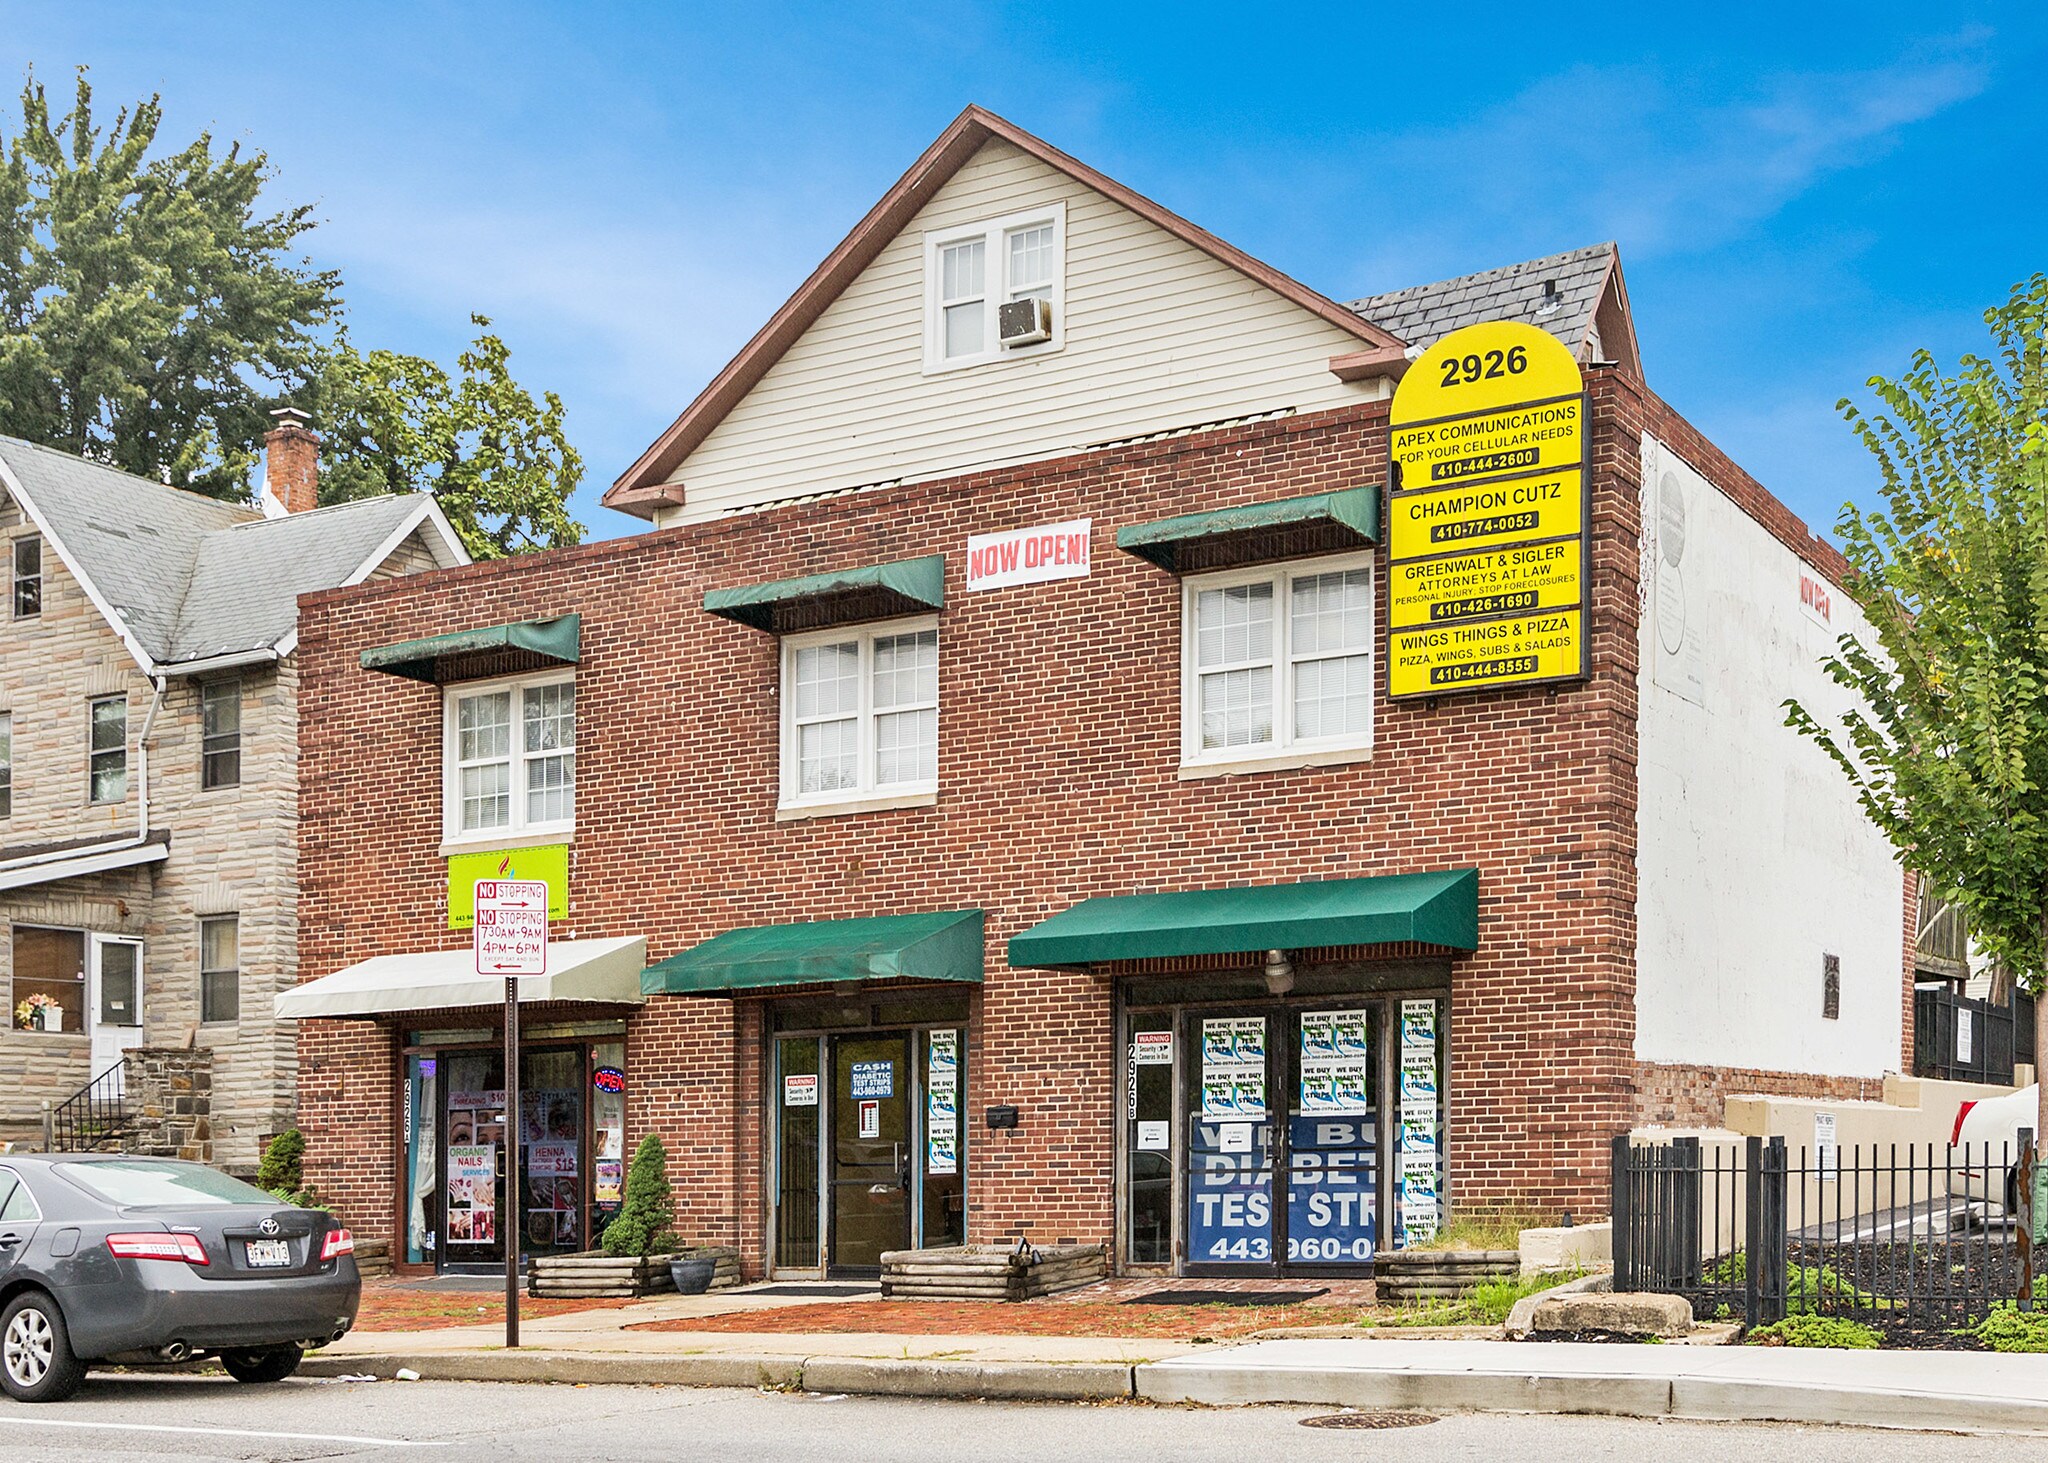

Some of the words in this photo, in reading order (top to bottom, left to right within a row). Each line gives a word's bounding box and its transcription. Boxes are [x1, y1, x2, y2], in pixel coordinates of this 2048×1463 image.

[1440, 345, 1528, 388] 2926
[1397, 430, 1435, 448] APEX
[1440, 406, 1576, 442] COMMUNICATIONS
[1400, 450, 1424, 464] FOR
[1427, 444, 1460, 459] YOUR
[1464, 433, 1528, 452] CELLULAR
[1531, 425, 1574, 441] NEEDS
[1437, 450, 1533, 477] 410-444-2600
[1410, 491, 1507, 520] CHAMPION
[1513, 482, 1561, 504] CUTZ
[1436, 514, 1533, 539] 410-774-0052
[970, 539, 1021, 581] NOW
[1025, 533, 1088, 568] OPEN!
[1405, 556, 1494, 580] GREENWALT
[1498, 554, 1508, 566] &
[1512, 545, 1565, 565] SIGLER
[1395, 593, 1440, 606] PERSONAL
[1479, 584, 1502, 594] STOP
[1504, 573, 1576, 591] FORECLOSURES
[1418, 572, 1497, 592] ATTORNEYS
[1501, 569, 1518, 581] AT
[1523, 564, 1552, 578] LAW
[1436, 593, 1532, 617] 410-426-1690
[1401, 632, 1449, 650] WINGS
[1453, 625, 1507, 644] THINGS
[1512, 623, 1522, 636] &
[1527, 617, 1570, 634] PIZZA
[1399, 655, 1434, 667] PIZZA,
[1436, 649, 1476, 662] WINGS,
[1479, 645, 1510, 657] SUBS
[1513, 643, 1521, 652] &
[1525, 636, 1571, 651] SALADS
[1436, 658, 1532, 682] 410-444-8555
[479, 883, 495, 898] NO
[499, 885, 542, 898] STOPPING
[479, 910, 495, 925] NO
[499, 912, 542, 925] STOPPING
[481, 926, 542, 939] 730AM-9AM
[482, 941, 540, 954] 4PM-6PM
[1138, 1035, 1170, 1043] WARNING
[1139, 1045, 1156, 1053] Security
[853, 1063, 891, 1071] CASH
[853, 1072, 891, 1080] DIABETIC
[594, 1071, 625, 1091] OPEN
[491, 1093, 505, 1102] $10
[1317, 1122, 1402, 1145] BU
[450, 1147, 488, 1157] ORGANIC
[457, 1157, 483, 1167] NAILS
[535, 1147, 566, 1157] HENNA
[555, 1157, 575, 1170] $15
[1205, 1152, 1402, 1185] DIBET
[1197, 1192, 1295, 1227] TES
[1308, 1192, 1398, 1227] STR
[1209, 1237, 1390, 1260] 443960-0
